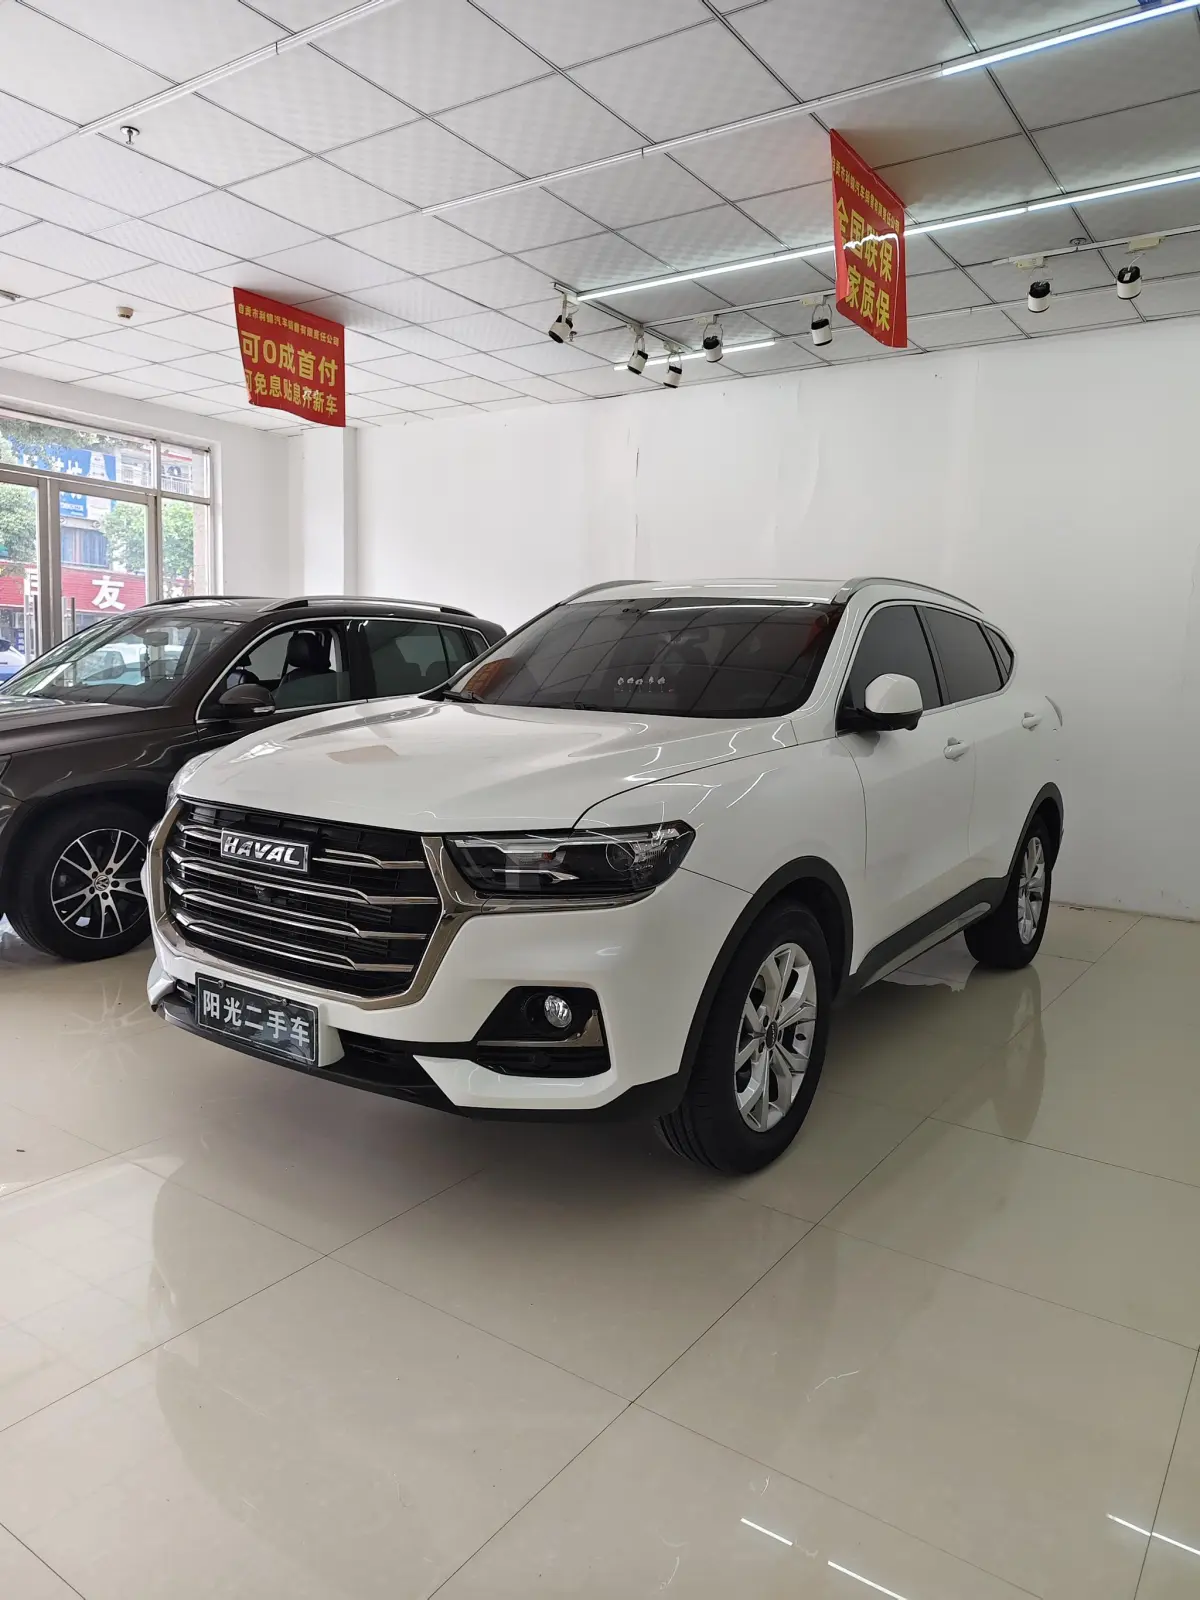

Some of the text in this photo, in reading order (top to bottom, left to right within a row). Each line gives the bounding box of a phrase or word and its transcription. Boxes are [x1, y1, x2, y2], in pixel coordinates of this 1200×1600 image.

[837, 197, 892, 282] 全国联保
[223, 836, 300, 866] HAVAL
[203, 990, 310, 1047] 阳光二手车
